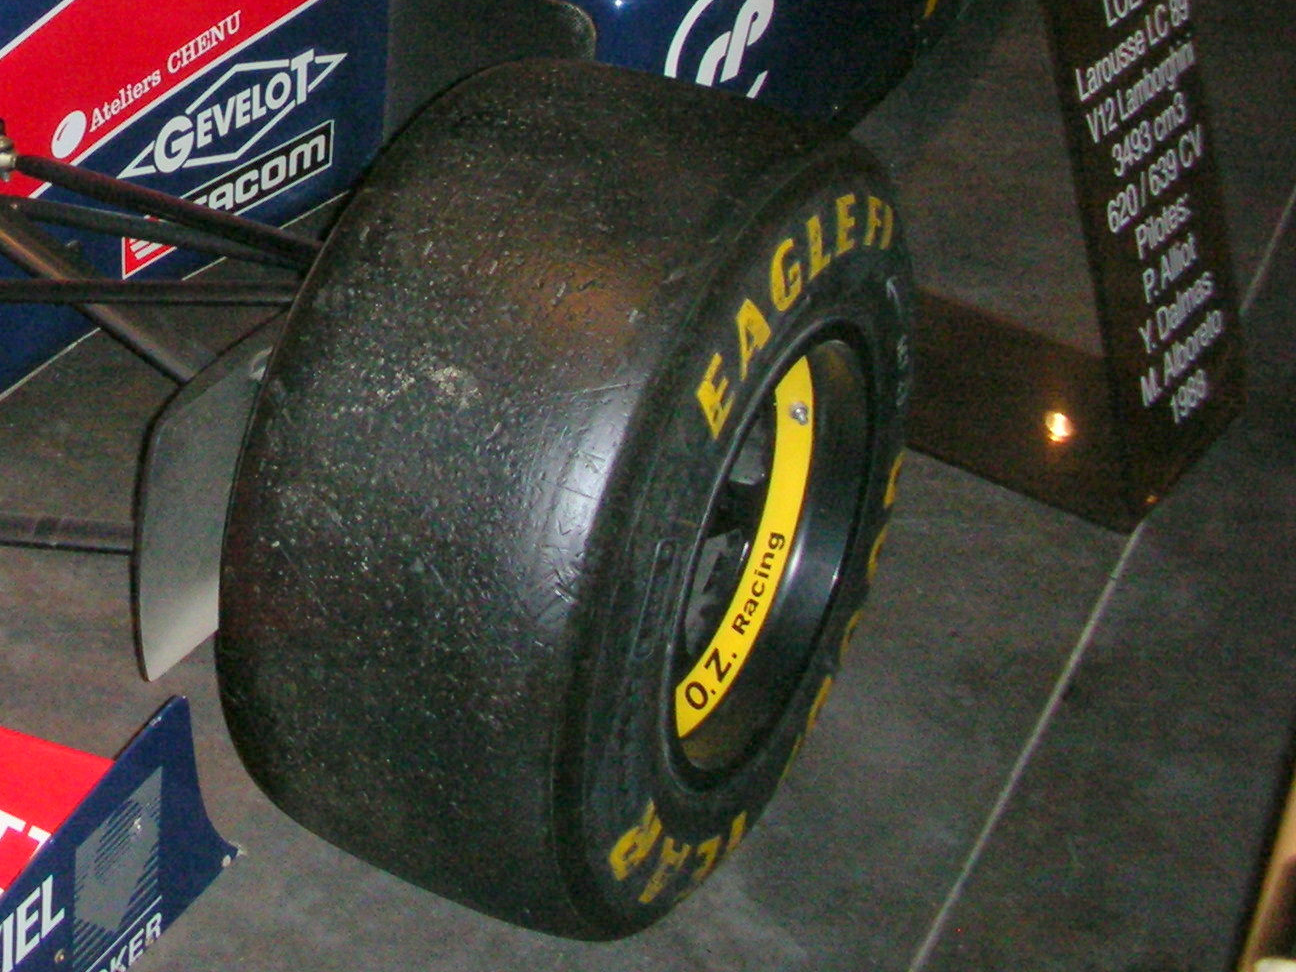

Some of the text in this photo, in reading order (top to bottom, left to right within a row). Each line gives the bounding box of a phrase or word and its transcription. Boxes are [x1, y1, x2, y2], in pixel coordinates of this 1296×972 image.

[89, 10, 243, 133] Ateliers CHENU
[1075, 29, 1147, 103] Larousse
[1144, 3, 1170, 48] LC
[1085, 31, 1196, 145] V12 Lamborghini
[153, 48, 317, 174] GEVELOT
[1111, 91, 1188, 178] 3493 cm3
[193, 133, 326, 211] ACOM
[1107, 183, 1139, 234] 620
[1148, 148, 1179, 197] 639
[1178, 124, 1203, 168] CV
[697, 193, 856, 441] EAGLE
[1138, 271, 1214, 355] Y. Dalmas
[1142, 231, 1198, 305] P. Alliot
[1163, 308, 1224, 388] Alboreto
[731, 530, 785, 637] Racing
